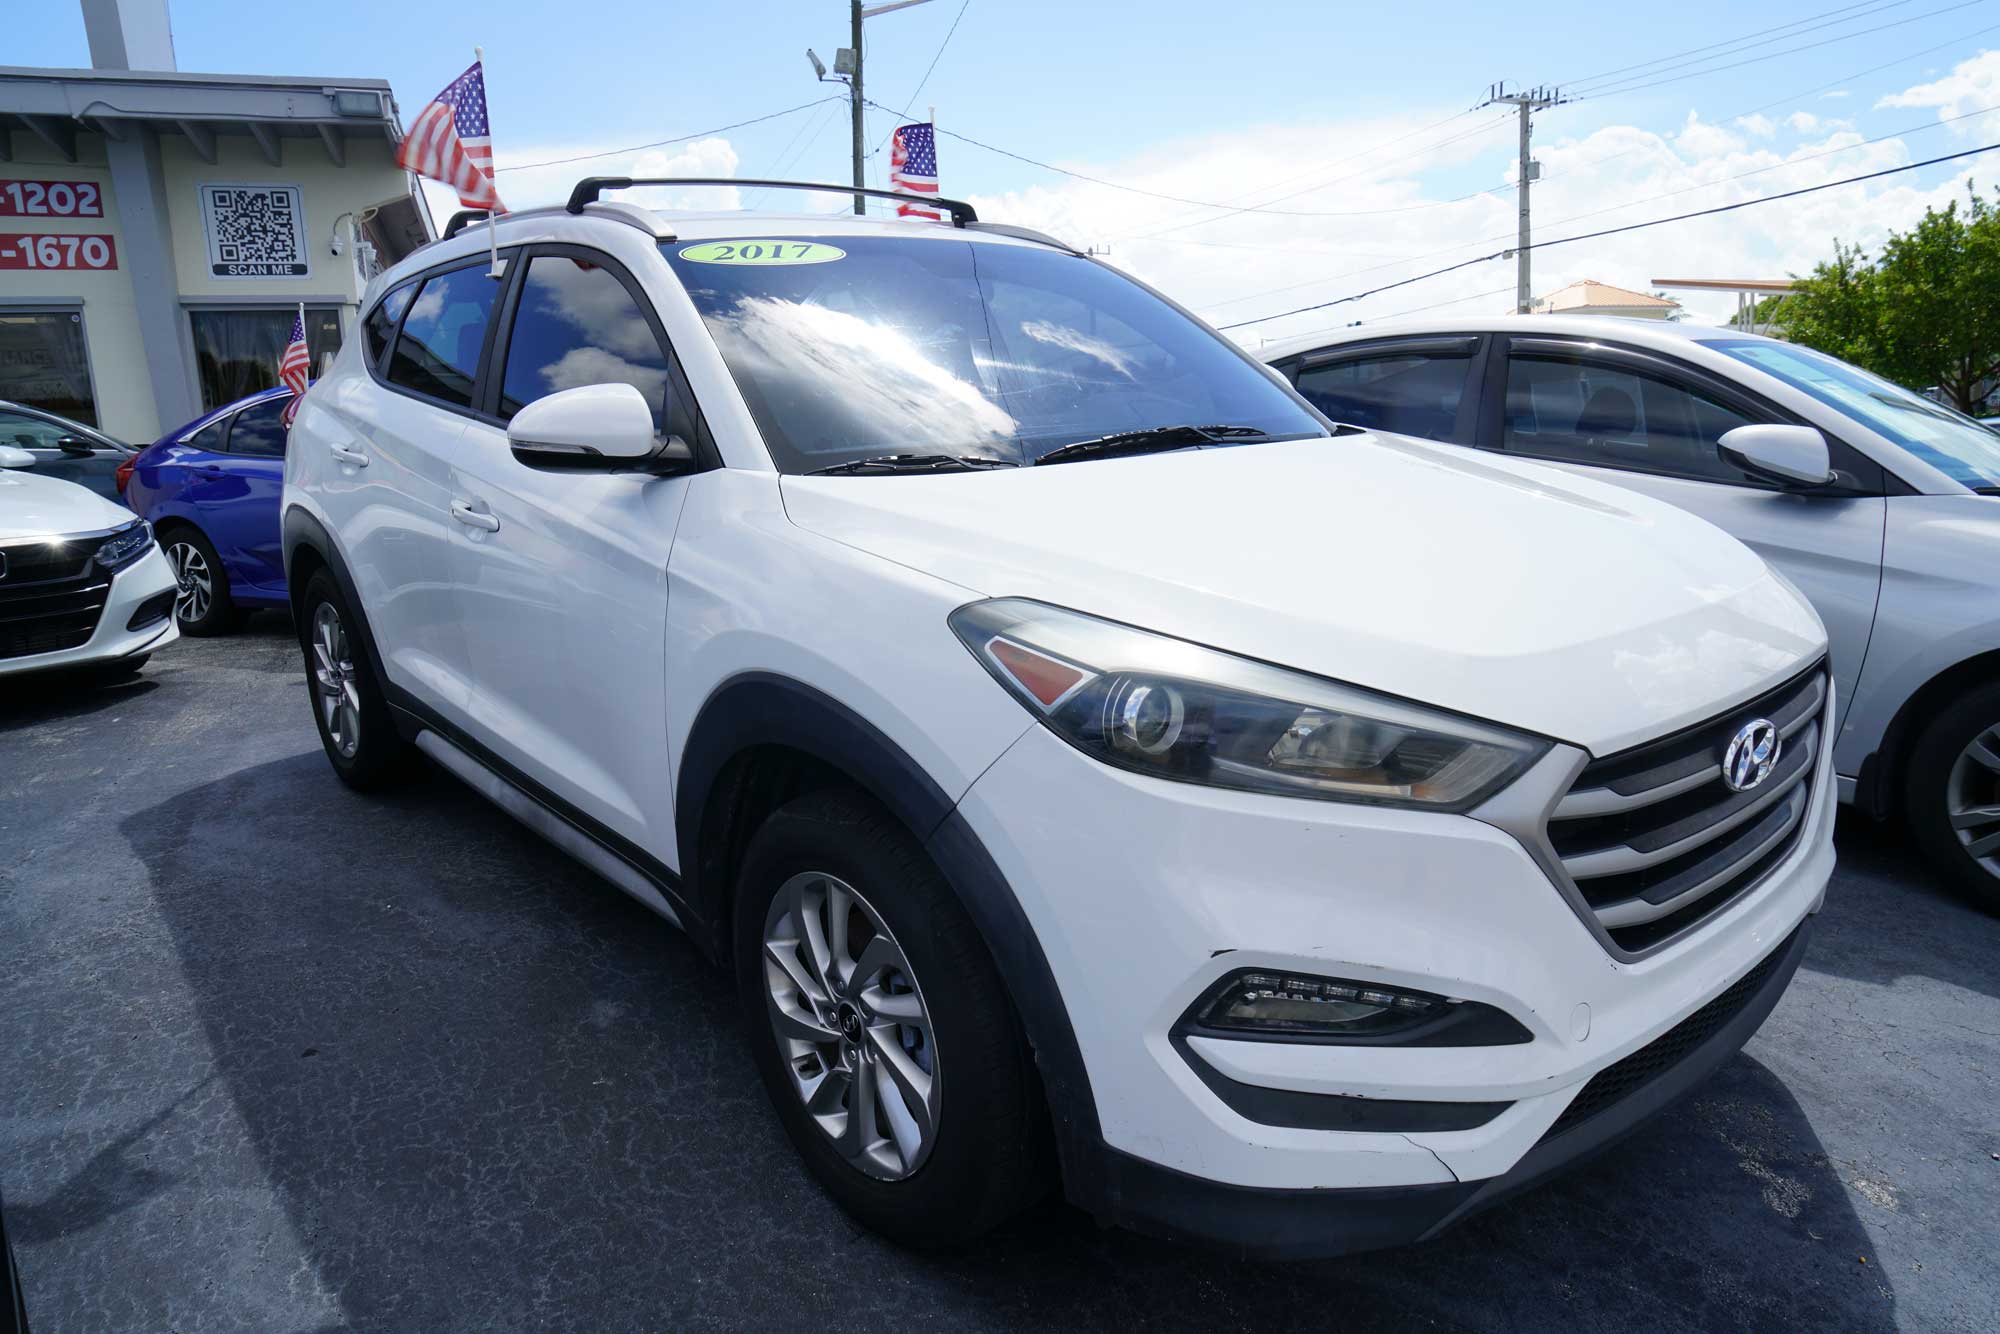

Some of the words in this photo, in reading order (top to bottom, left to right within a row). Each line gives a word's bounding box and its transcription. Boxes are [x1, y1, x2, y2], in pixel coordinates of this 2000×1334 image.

[1, 236, 110, 268] -1670
[713, 244, 812, 260] 2017
[228, 265, 267, 274] SCAN
[271, 265, 293, 274] ME
